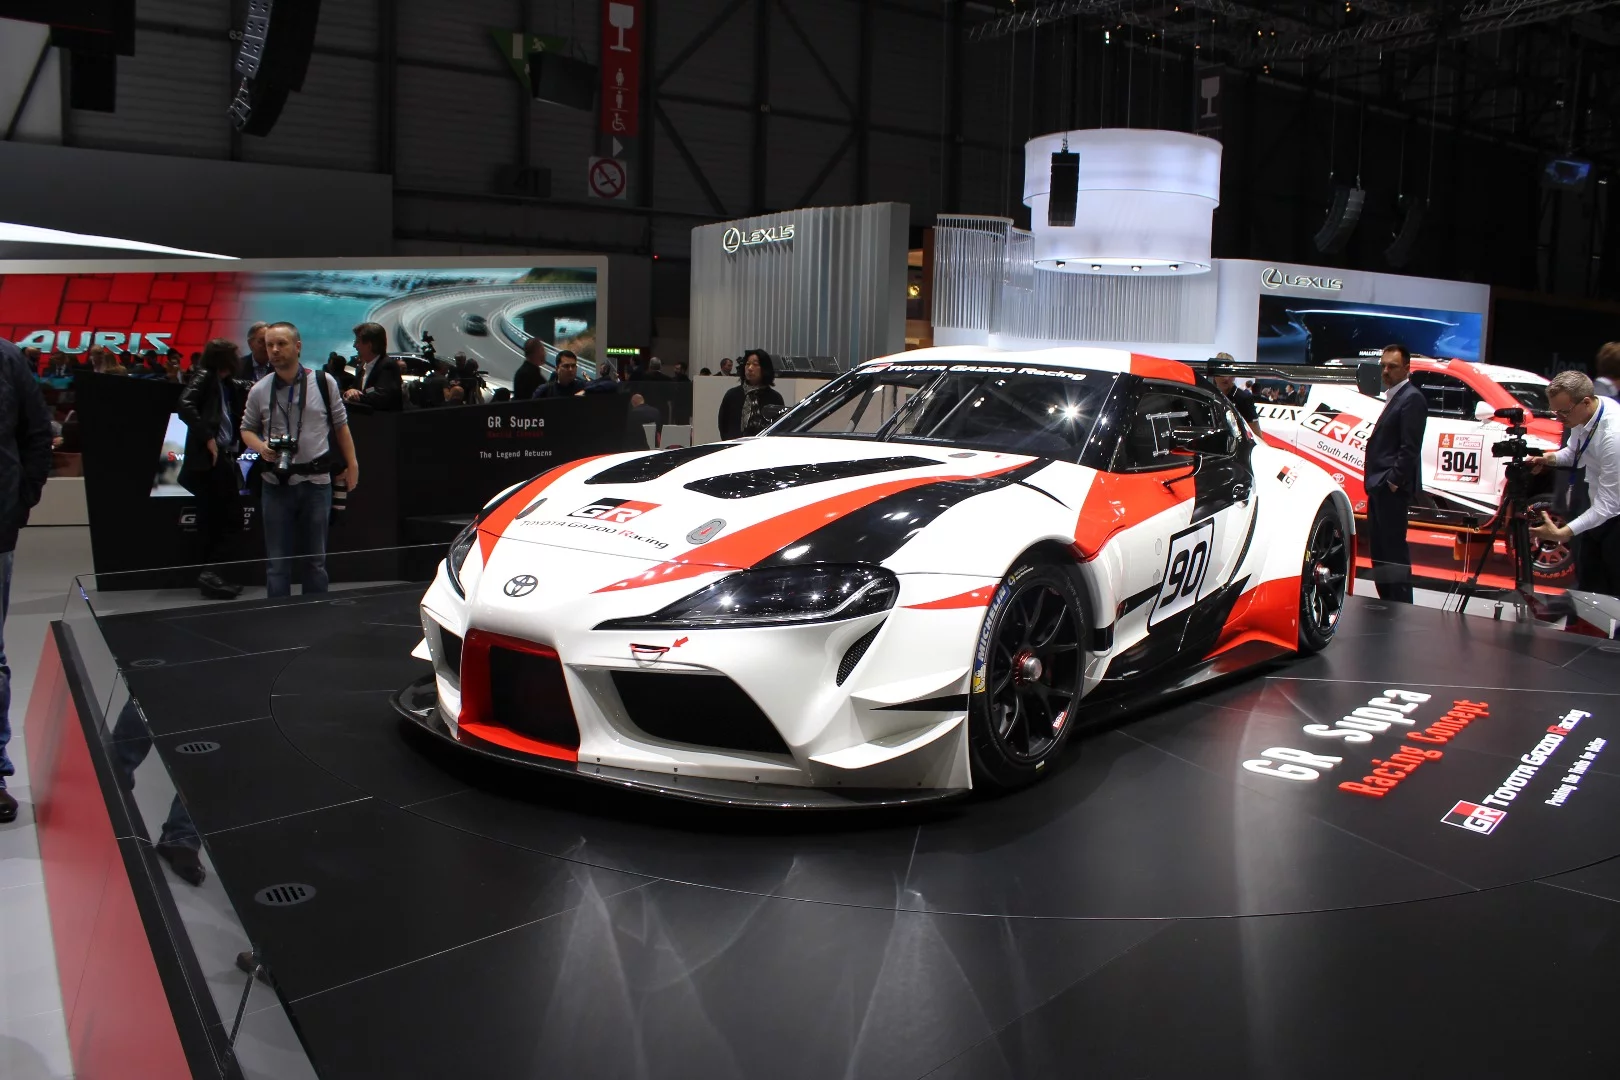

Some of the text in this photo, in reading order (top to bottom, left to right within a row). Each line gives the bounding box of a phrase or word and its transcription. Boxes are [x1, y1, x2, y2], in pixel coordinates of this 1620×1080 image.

[742, 224, 794, 245] LEXUS
[1285, 273, 1344, 291] LEXUS
[16, 329, 171, 355] AURIS
[1017, 367, 1088, 381] Racing
[487, 416, 545, 430] GR Supra
[1302, 413, 1351, 443] GR
[496, 450, 521, 460] Legend
[524, 449, 553, 458] Returns
[1316, 441, 1341, 457] South
[1441, 450, 1478, 473] 304
[571, 504, 645, 523] GR
[617, 529, 670, 550] Racing
[1158, 540, 1208, 609] 90
[977, 585, 1007, 663] MICHELIN
[1052, 711, 1065, 728] BBS
[1242, 689, 1432, 781] GR Supra
[1338, 699, 1490, 798] Racing Concept
[1482, 766, 1539, 807] TOYOTA
[1546, 709, 1592, 736] Racing
[1560, 774, 1581, 784] the
[1544, 783, 1578, 807] Pushing
[1463, 806, 1502, 832] GR
